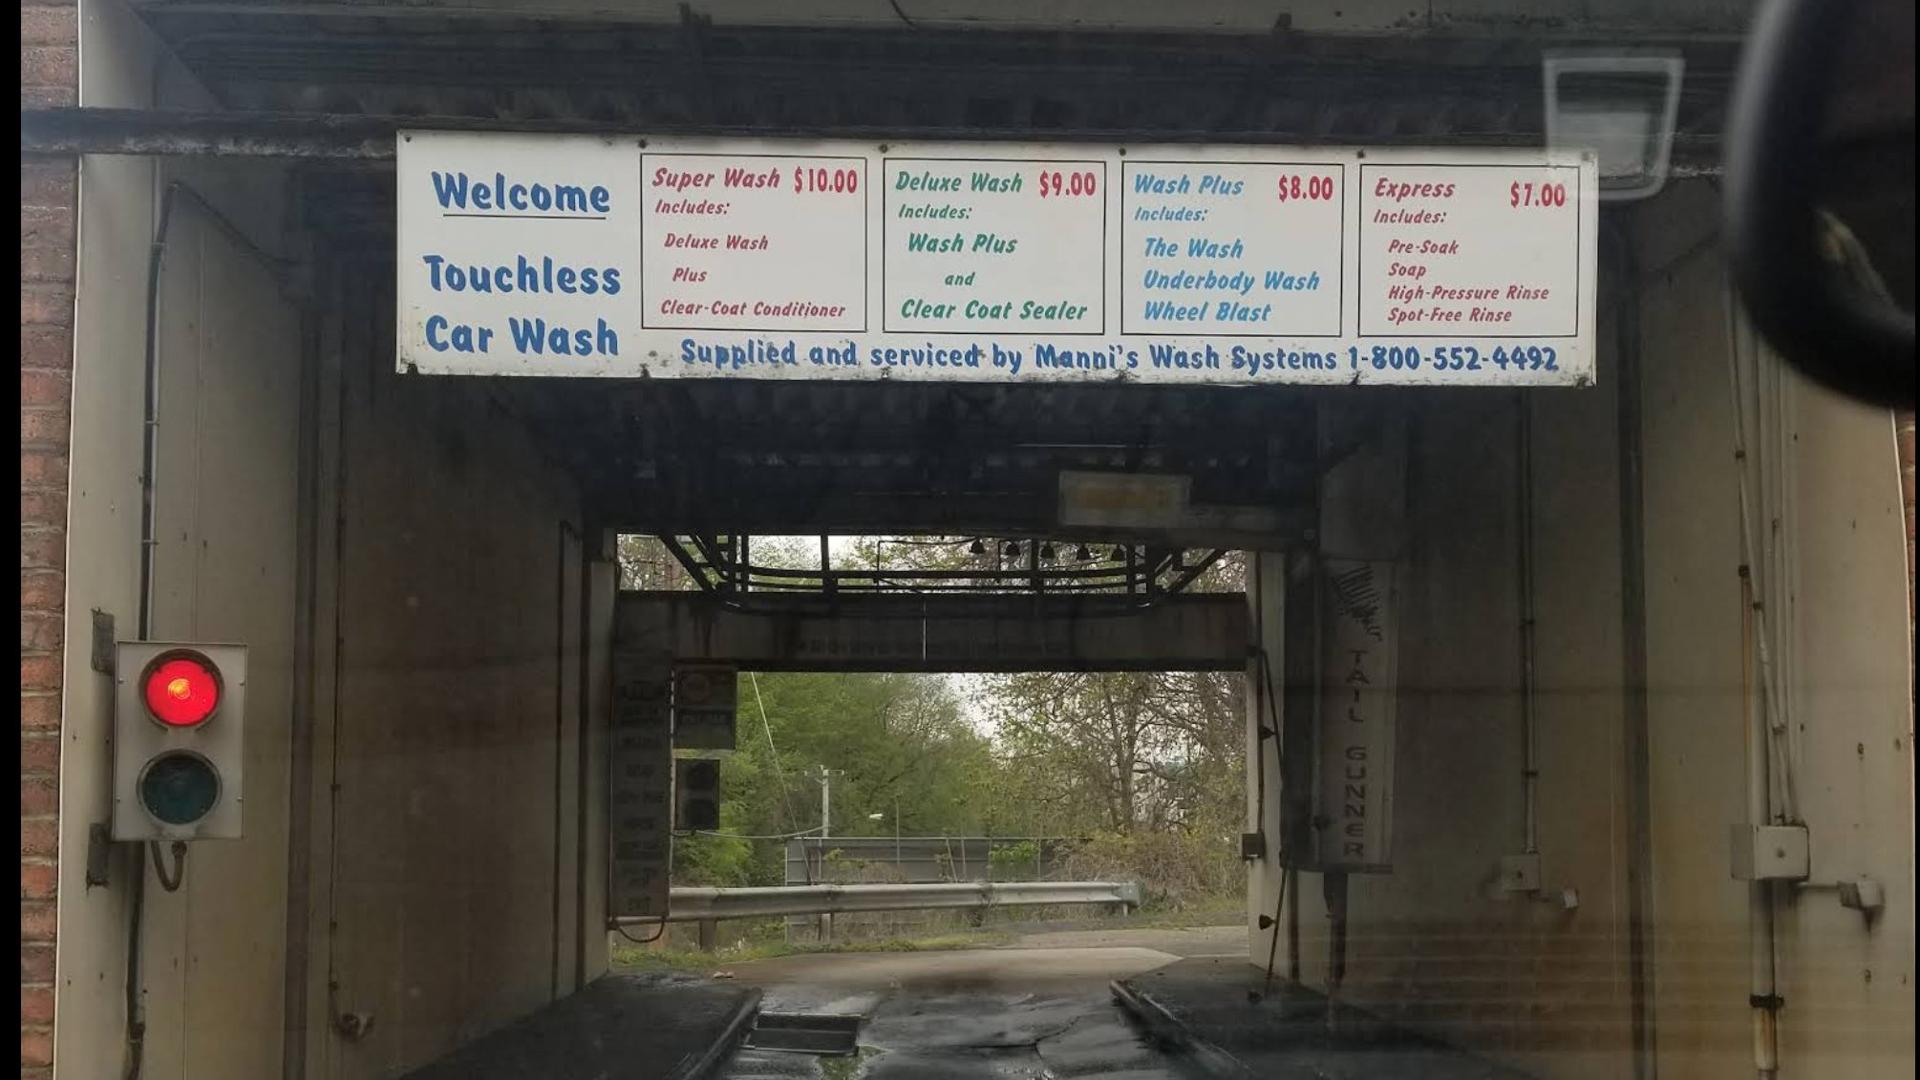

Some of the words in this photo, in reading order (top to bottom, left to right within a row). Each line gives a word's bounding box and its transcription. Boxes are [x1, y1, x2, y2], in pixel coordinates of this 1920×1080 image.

[652, 168, 715, 192] Super
[724, 168, 780, 188] Wash
[795, 166, 857, 193] $10.00
[896, 171, 961, 192] Deluxe
[971, 172, 1022, 192] Wash
[1040, 170, 1096, 198] $9.00
[1135, 174, 1190, 194] Wash
[1198, 175, 1244, 195] Plus
[1279, 175, 1333, 202] $8.00
[431, 171, 610, 213] Welcome
[1375, 178, 1455, 202] Express
[1511, 181, 1565, 208] $7.00
[655, 199, 730, 214] Includes:
[899, 204, 972, 219] Includes:
[1135, 206, 1208, 221] Includes:
[1374, 209, 1446, 224] Includes:
[664, 233, 719, 249] Deluxe
[726, 235, 768, 250] Wash
[908, 232, 964, 253] Wash
[972, 233, 1017, 253] Plus
[1145, 237, 1178, 257] The
[1188, 238, 1243, 258] Wash
[1388, 239, 1459, 254] Pre-Soak
[423, 255, 621, 295] Touchless
[672, 267, 707, 282] Plus
[945, 272, 975, 286] and
[1388, 262, 1426, 280] Soap
[1144, 270, 1255, 296] Underbody
[1264, 271, 1319, 290] Wash
[1389, 285, 1499, 304] High-Pressure
[1506, 285, 1549, 299] Rinse
[661, 299, 747, 315] Clear-Coat
[754, 302, 845, 318] Conditioner
[901, 299, 956, 319] Clear
[965, 300, 1012, 319] Coat
[1019, 301, 1087, 320] Sealer
[1145, 301, 1209, 321] Wheel
[1216, 302, 1271, 322] Blast
[1388, 307, 1462, 326] Spot-Free
[1469, 307, 1511, 322] Rinse
[426, 315, 493, 353] Car
[509, 317, 618, 356] Wash
[681, 339, 799, 370] Supplied
[809, 341, 858, 365] and
[871, 342, 979, 368] serviced
[992, 343, 1022, 374] by
[1036, 344, 1138, 369] Manni's
[1149, 344, 1219, 369] Wash
[1231, 345, 1336, 376] Systems
[1349, 345, 1558, 371] 1-800-552-4492
[1345, 650, 1371, 724] TAIL
[1343, 746, 1367, 857] GUNNER
